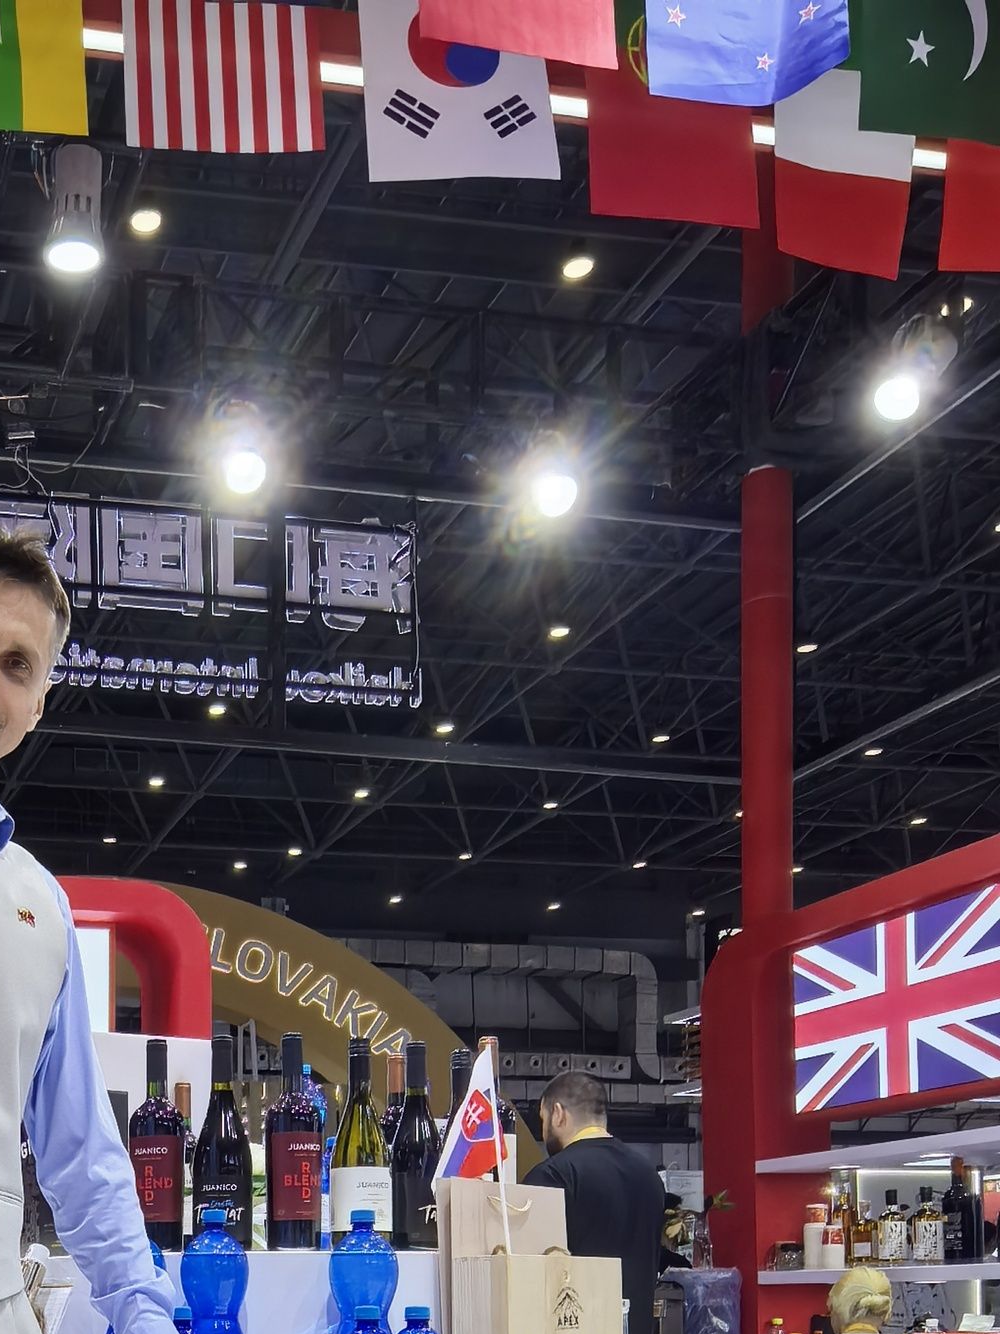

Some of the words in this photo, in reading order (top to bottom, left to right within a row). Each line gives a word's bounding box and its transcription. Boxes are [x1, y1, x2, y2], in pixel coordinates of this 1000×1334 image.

[202, 924, 412, 1056] LOVAKIA
[134, 1146, 169, 1156] JUANICO
[137, 1176, 173, 1190] LEND
[201, 1183, 238, 1192] JUANICO
